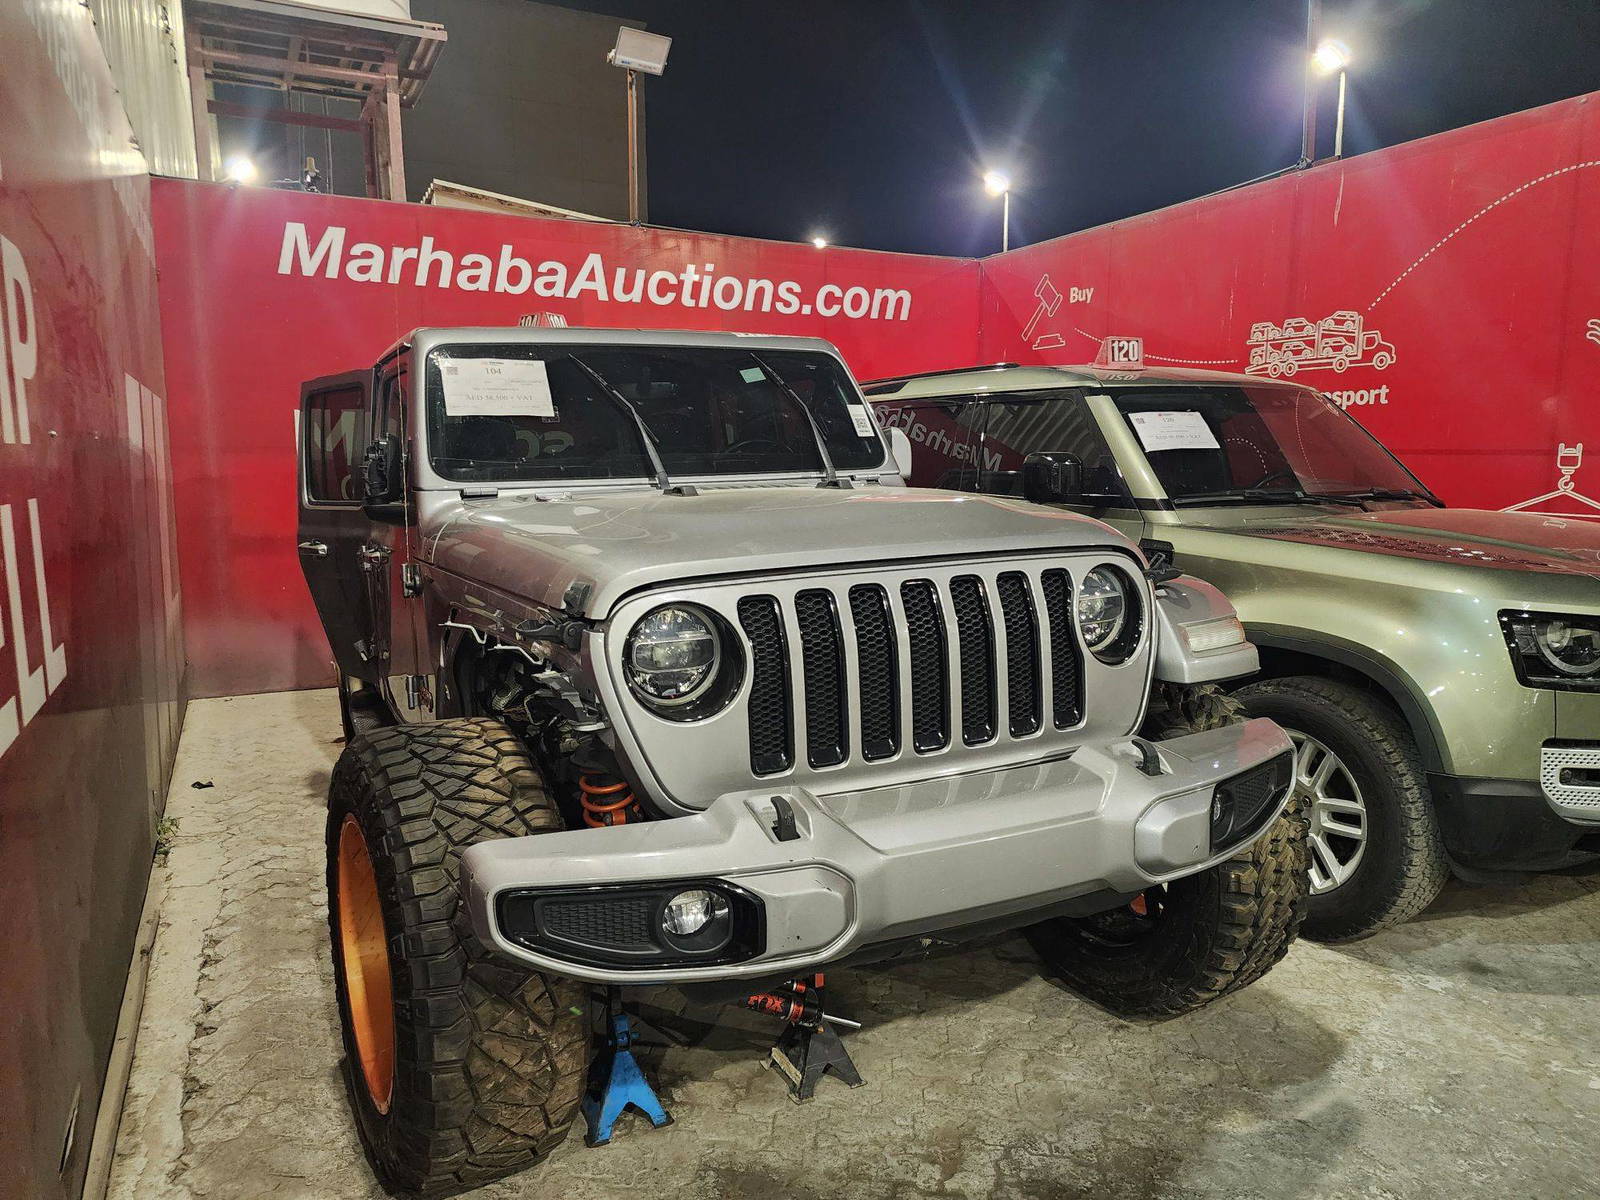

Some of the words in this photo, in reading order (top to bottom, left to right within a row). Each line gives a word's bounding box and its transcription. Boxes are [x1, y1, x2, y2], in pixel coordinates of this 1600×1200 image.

[277, 220, 912, 321] MarhabaAuctions.com
[1069, 287, 1094, 303] Buy
[1111, 340, 1139, 362] 120
